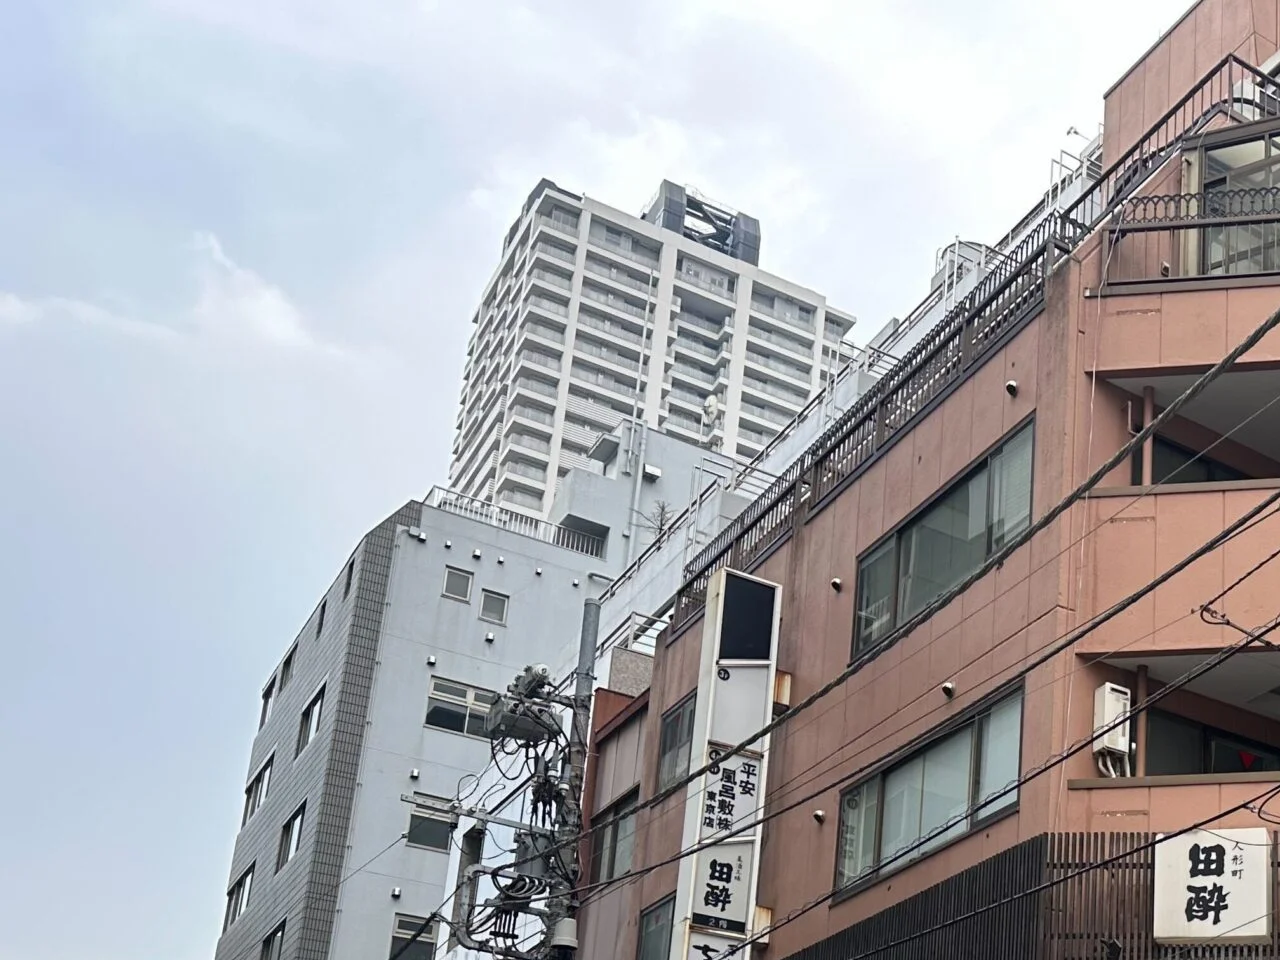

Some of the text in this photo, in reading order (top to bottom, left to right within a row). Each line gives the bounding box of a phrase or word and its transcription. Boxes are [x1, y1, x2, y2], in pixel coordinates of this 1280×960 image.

[739, 762, 757, 797] 平安
[703, 791, 717, 828] 東京店
[1231, 841, 1244, 879] 人形町
[703, 858, 734, 912] 田酔
[1185, 843, 1231, 925] 田酔
